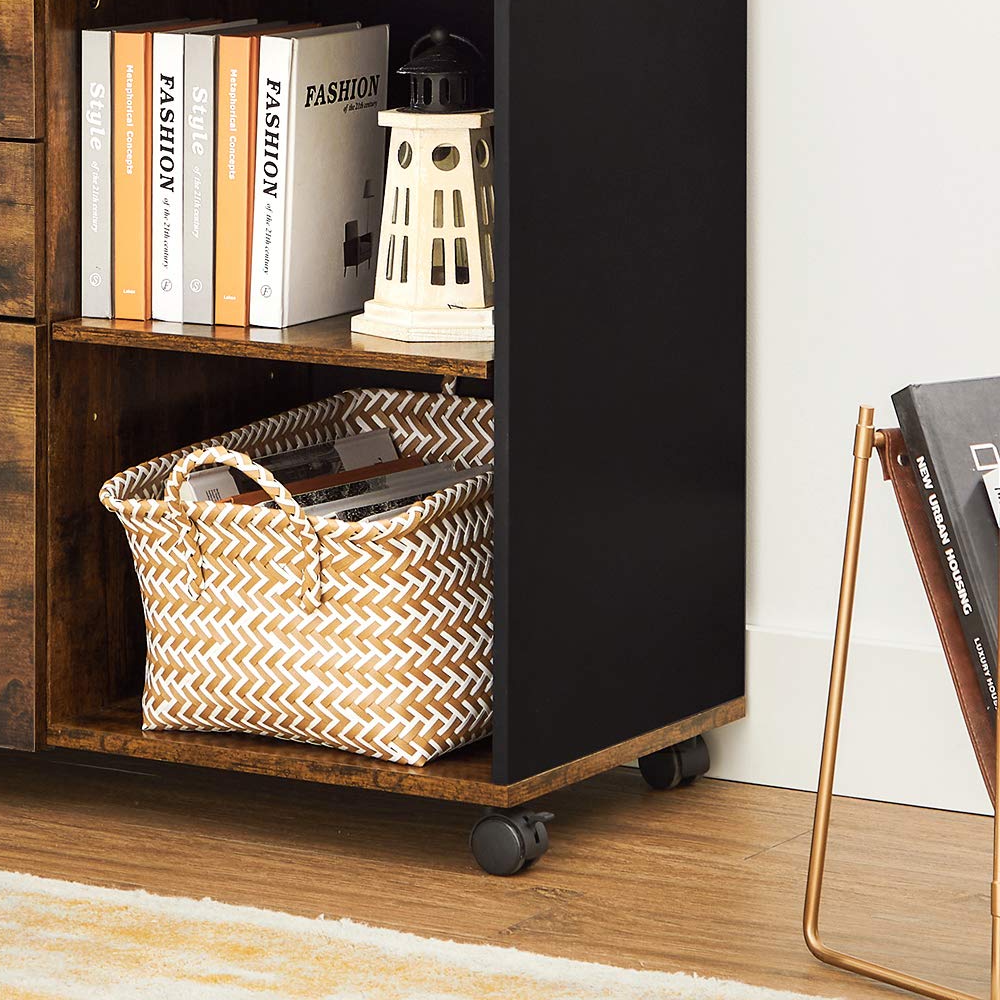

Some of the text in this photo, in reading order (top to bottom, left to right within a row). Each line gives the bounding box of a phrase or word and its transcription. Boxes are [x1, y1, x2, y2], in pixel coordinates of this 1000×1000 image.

[304, 74, 380, 108] FASHION
[86, 82, 106, 150] Style
[125, 64, 134, 174] Metaphorical Concepts
[160, 73, 174, 192] FASHION
[188, 86, 208, 156] Style
[228, 69, 238, 180] Metaphorical Concepts
[262, 78, 281, 198] FASHION
[90, 160, 100, 171] of
[192, 166, 202, 176] of
[194, 177, 202, 190] the
[91, 204, 99, 232] century
[162, 198, 170, 207] of
[265, 204, 273, 214] of
[192, 208, 200, 240] century
[262, 246, 270, 275] century
[916, 456, 972, 616] NEW URBAN HOUSING
[974, 637, 991, 676] LUXURY
